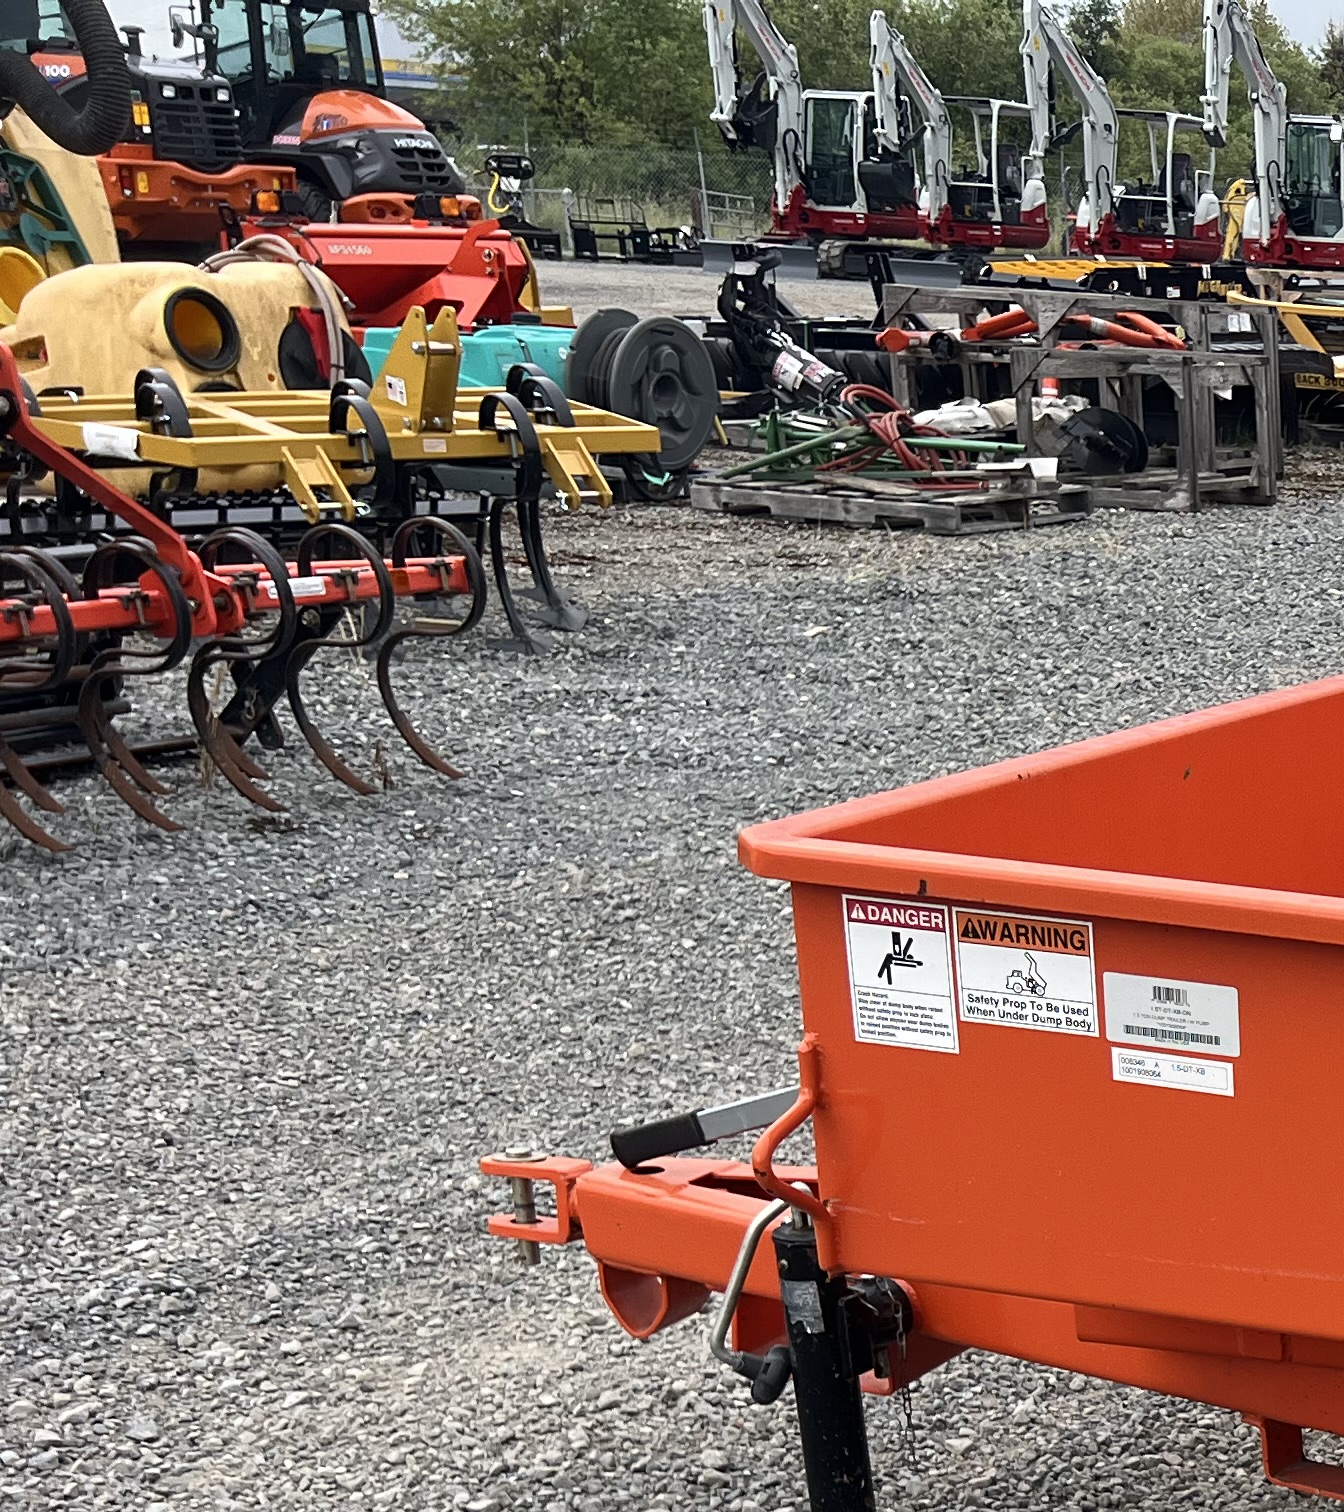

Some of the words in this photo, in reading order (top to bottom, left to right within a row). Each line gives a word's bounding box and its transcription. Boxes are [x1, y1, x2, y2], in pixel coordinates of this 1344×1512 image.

[44, 64, 70, 78] 100
[393, 138, 435, 149] HITACHI
[867, 905, 944, 929] DANGER
[977, 919, 1086, 951] WARNING
[967, 993, 999, 1008] Safety
[1002, 997, 1027, 1011] Prop
[1029, 1000, 1043, 1011] To
[1046, 1003, 1059, 1013] Be
[1062, 1004, 1089, 1017] Used
[966, 1005, 995, 1017] When
[998, 1008, 1029, 1021] Under
[1032, 1013, 1062, 1028] Dump
[1065, 1016, 1092, 1032] Body
